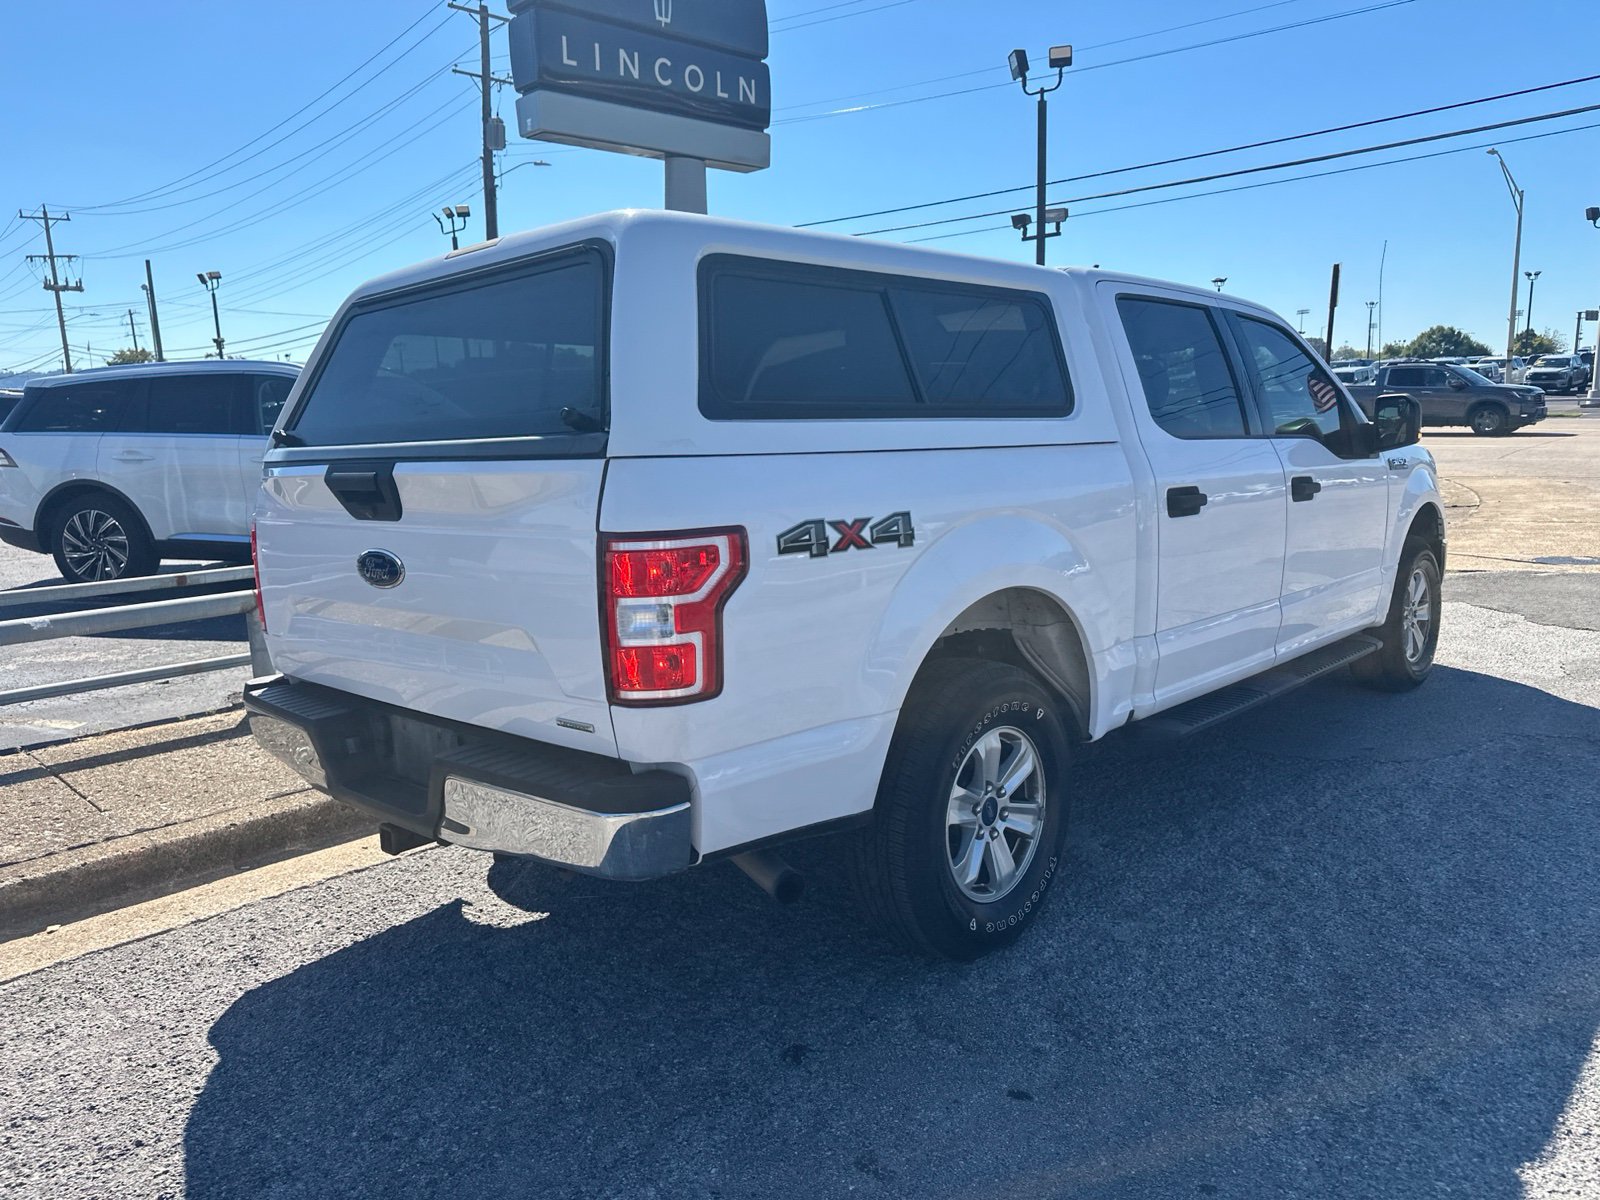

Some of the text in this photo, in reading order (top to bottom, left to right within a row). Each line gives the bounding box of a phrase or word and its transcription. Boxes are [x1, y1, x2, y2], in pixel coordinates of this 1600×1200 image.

[561, 35, 756, 105] LINCOLN
[363, 556, 391, 580] Ford
[985, 856, 1058, 933] Firestone
